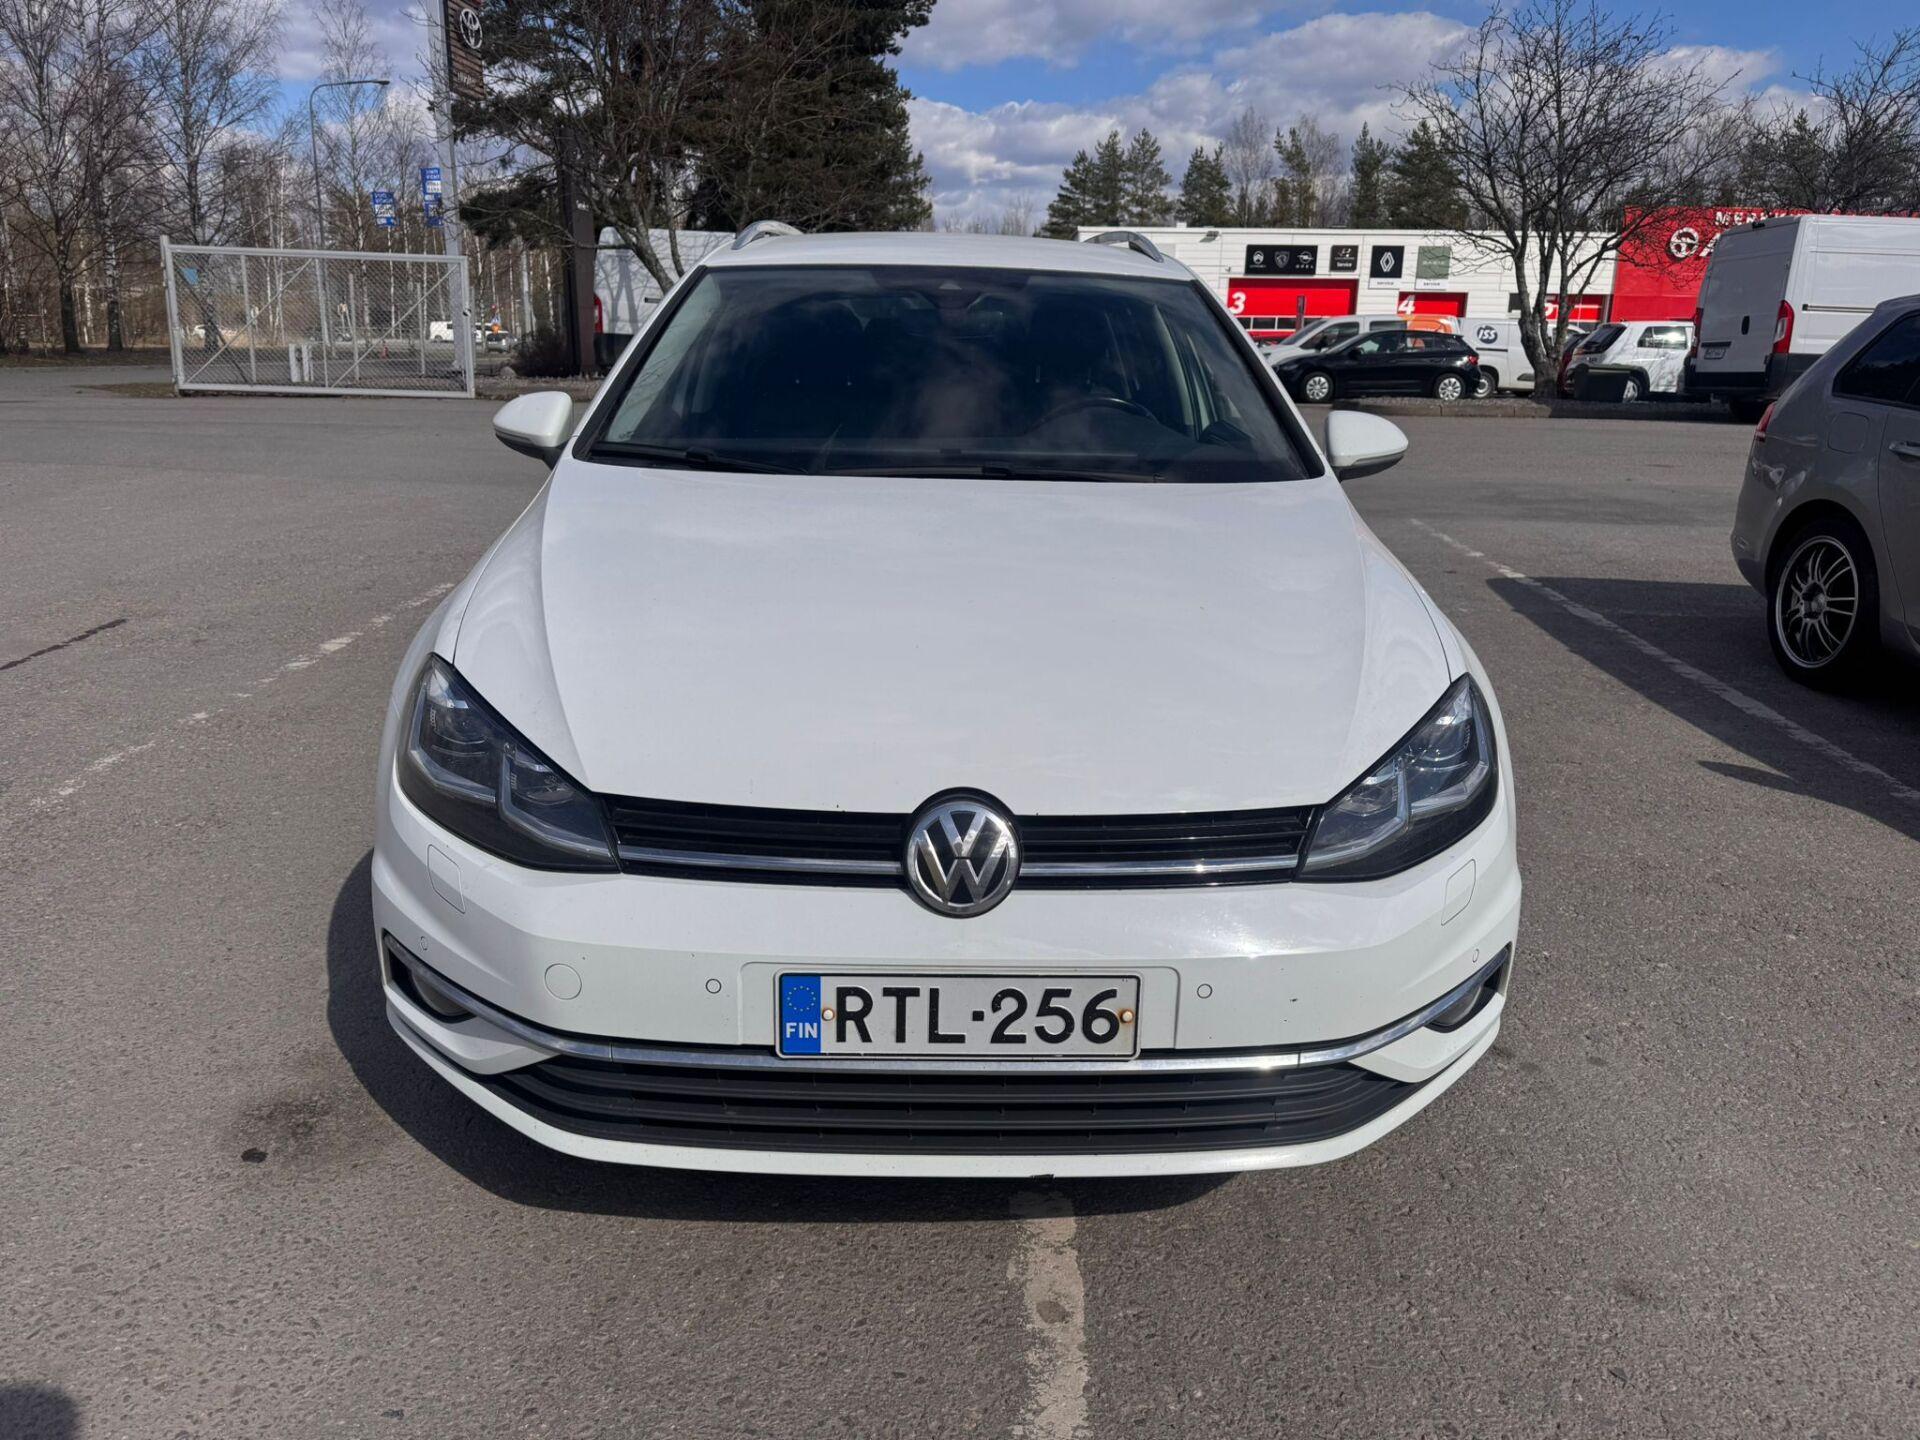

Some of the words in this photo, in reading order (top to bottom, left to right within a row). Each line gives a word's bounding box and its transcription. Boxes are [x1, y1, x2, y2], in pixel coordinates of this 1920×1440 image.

[1229, 291, 1246, 314] 3
[1398, 294, 1416, 315] 4
[785, 1022, 818, 1039] FIN
